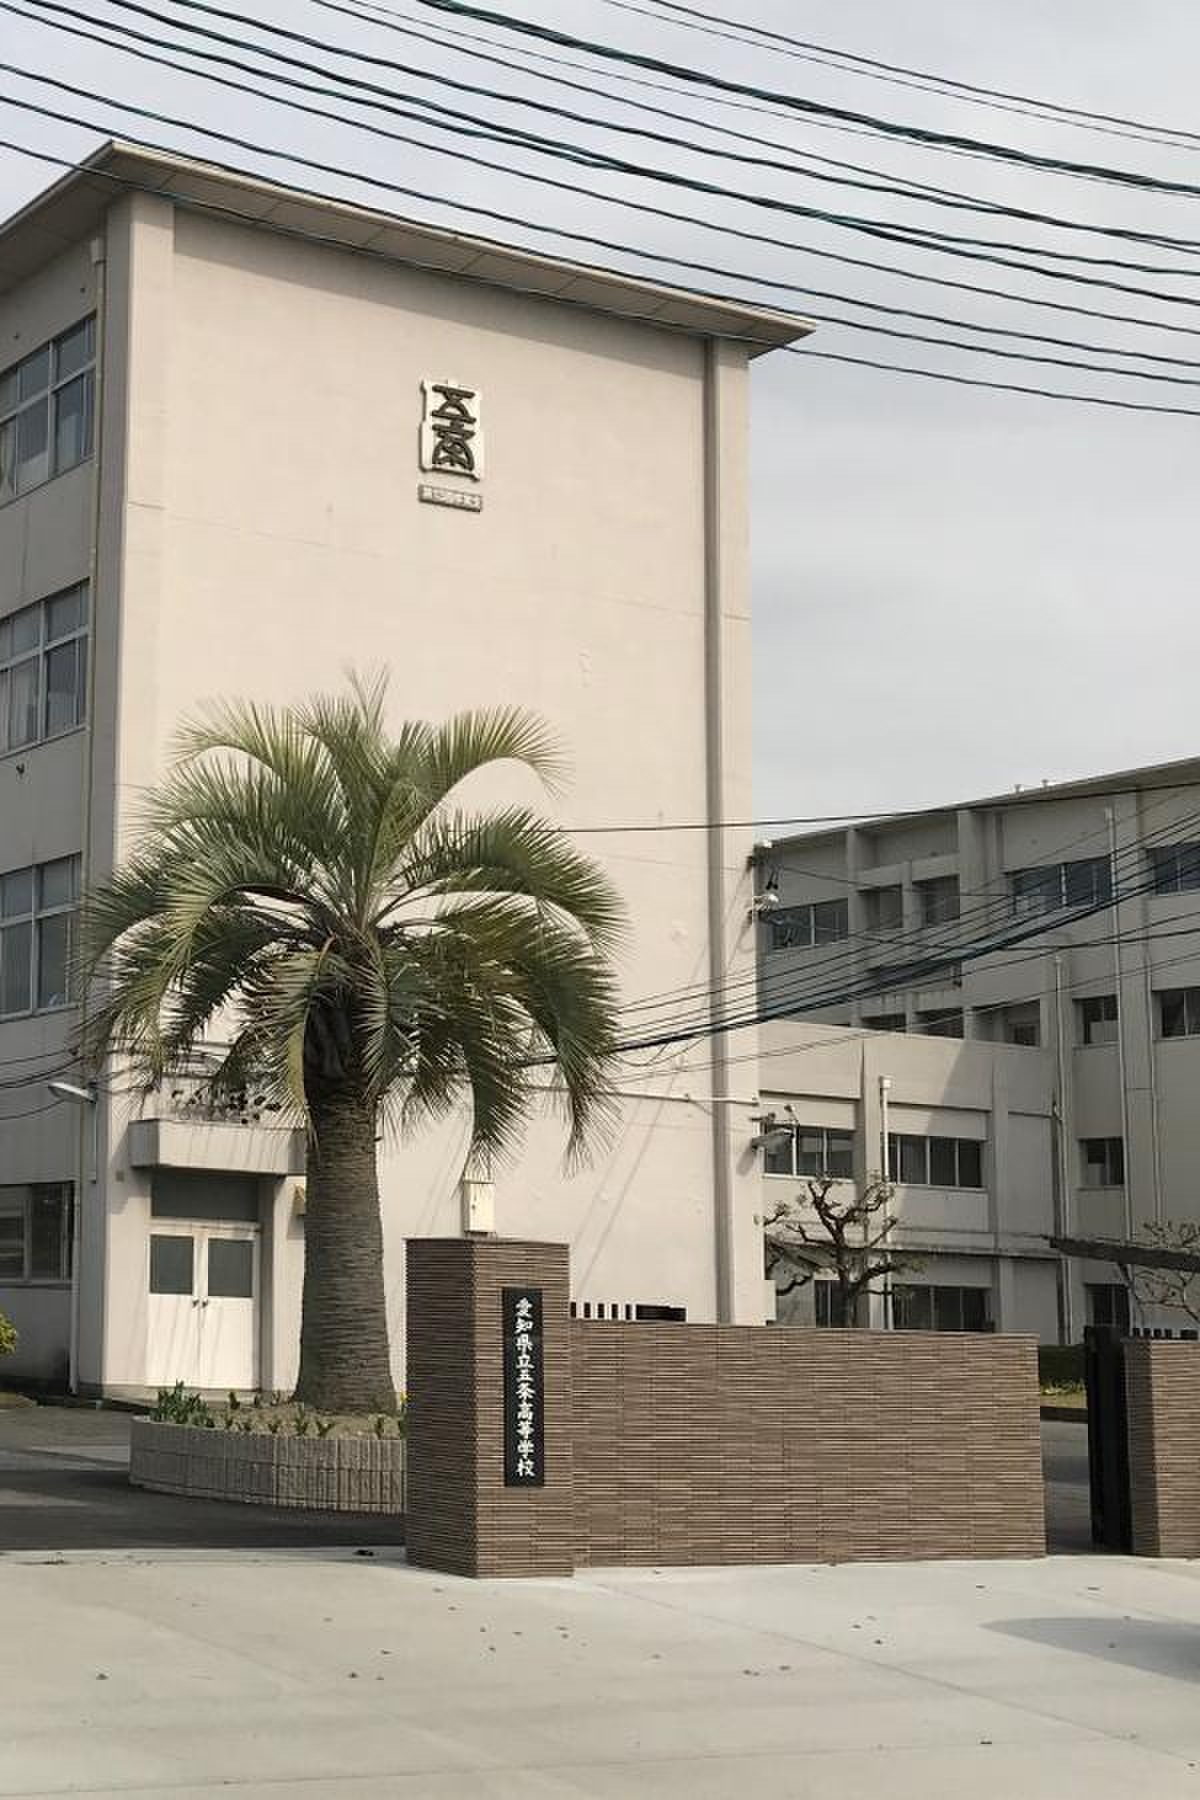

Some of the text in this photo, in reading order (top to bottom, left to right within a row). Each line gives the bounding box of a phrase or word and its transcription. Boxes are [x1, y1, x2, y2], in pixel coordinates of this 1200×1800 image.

[514, 1297, 536, 1477] 愛知県立五条高等学校
